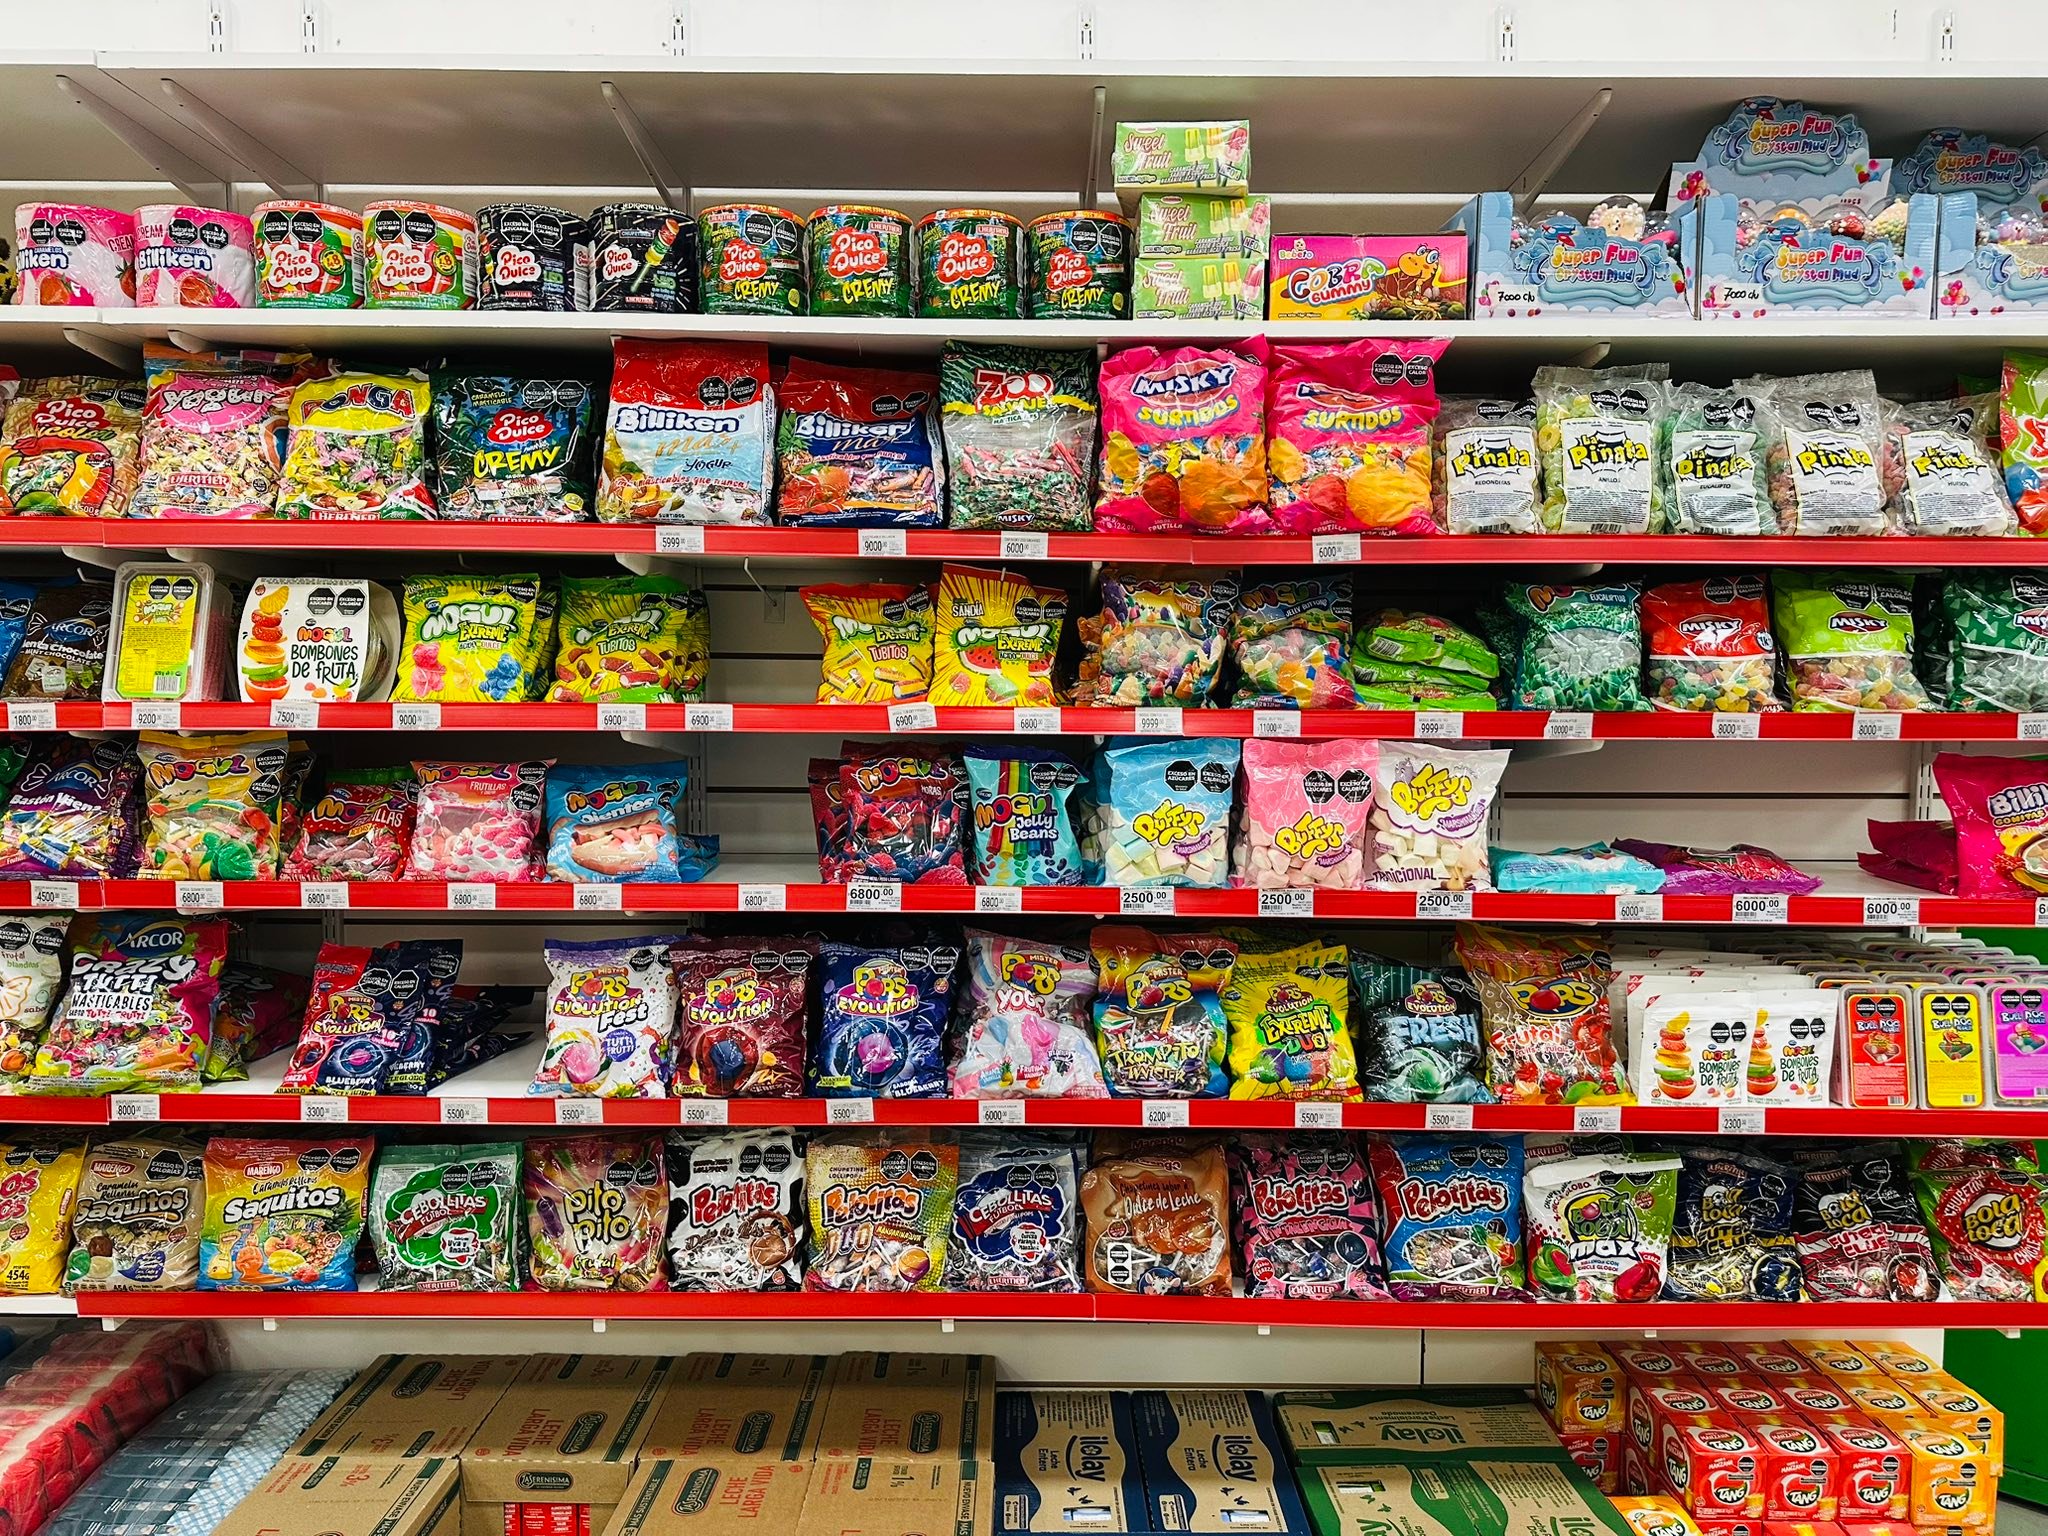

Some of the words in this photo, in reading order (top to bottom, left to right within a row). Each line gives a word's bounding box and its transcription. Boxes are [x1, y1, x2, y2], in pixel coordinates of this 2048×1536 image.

[1750, 120, 1798, 145] Super
[1803, 116, 1834, 134] Fun
[1123, 131, 1167, 154] Sweet
[1752, 141, 1800, 161] Crystal
[1803, 144, 1827, 159] Mud
[1937, 151, 1981, 172] Super
[1985, 148, 2018, 167] Fun
[1940, 170, 1983, 186] Crystal
[1985, 168, 2013, 183] Mud
[1150, 203, 1190, 222] Sweet
[137, 246, 212, 270] Billiken
[837, 236, 876, 257] Pico
[945, 237, 982, 260] Pico
[1551, 244, 1601, 267] Super
[1605, 244, 1639, 263] Fun
[1776, 244, 1827, 268] Super
[1830, 244, 1865, 263] Fun
[275, 253, 307, 271] Pico
[502, 254, 531, 268] Pico
[828, 253, 881, 275] Dulce
[940, 254, 988, 277] Dulce
[271, 268, 313, 286] Dulce
[1288, 259, 1387, 300] COBRA
[1556, 264, 1605, 282] Crystal
[1608, 266, 1635, 282] Mud
[1779, 264, 1830, 282] Crystal
[1832, 265, 1860, 281] Mud
[734, 278, 780, 301] CREMY
[842, 278, 894, 304] CREMY
[949, 280, 1001, 310] CREMY
[1060, 284, 1105, 309] CREMY
[974, 366, 1054, 404] ZOO
[1135, 365, 1236, 395] MISKY
[471, 392, 507, 402] CARAMELO
[498, 414, 540, 430] Pico
[615, 406, 739, 433] Billiken
[1303, 407, 1402, 432] SURTIDOS
[496, 424, 546, 441] Dulce
[473, 446, 561, 480] CREMY
[1567, 441, 1649, 472] Piñata
[1675, 460, 1752, 482] Piñata
[996, 513, 1034, 523] MISKY
[1241, 581, 1321, 611] MOGUL
[422, 602, 518, 641] MOGUL
[458, 621, 509, 643] EXTREME
[1682, 621, 1739, 636] MISKY
[1831, 616, 1887, 630] MISKY
[296, 626, 353, 642] MOGUL
[50, 643, 104, 661] Chocolate
[291, 645, 359, 663] BOMBONES
[597, 639, 636, 661] TUBITOS
[870, 648, 909, 666] TUBITOS
[150, 762, 249, 790] MOGUL
[421, 764, 509, 788] MOGUL
[470, 781, 506, 791] FRUTILLAS
[976, 795, 1056, 829] MOGUL
[1133, 801, 1204, 846] Buffys
[1010, 825, 1057, 842] Beans
[1016, 815, 1052, 833] Jelly
[7, 960, 40, 970] blanditos
[731, 970, 753, 981] MISTER
[1152, 966, 1183, 979] MISTER
[71, 993, 151, 1010] MASTICABLES
[840, 997, 917, 1015] EVOLUTION
[1407, 1001, 1456, 1013] EVOLUTION
[314, 1018, 384, 1034] EVOLUTION
[599, 1003, 648, 1031] Fest
[1259, 1006, 1331, 1043] EXTREME
[1394, 1013, 1475, 1046] FRESH
[606, 1036, 634, 1048] TUTTI
[606, 1046, 635, 1058] FRUTTI
[1283, 1032, 1327, 1056] DUO
[1107, 1041, 1199, 1068] TROMPITO
[325, 1075, 377, 1086] BLUEBERRY
[94, 1164, 132, 1179] MARENGO
[246, 1164, 283, 1177] MARENGO
[96, 1182, 139, 1196] Caramelos
[1252, 1181, 1347, 1219] Pelotitas
[1399, 1181, 1508, 1219] Pelotitas
[76, 1192, 186, 1220] Saquitos
[225, 1184, 342, 1222] Saquitos
[401, 1194, 488, 1226] CEBOLLITAS
[694, 1179, 780, 1228] Pelotitas
[825, 1183, 921, 1227] Pelotitas
[968, 1187, 1053, 1222] CEBOLLITAS
[1124, 1193, 1155, 1219] Dulce
[1156, 1193, 1171, 1210] de
[1173, 1189, 1203, 1212] Leche
[1965, 1194, 2021, 1231] BOLA
[1569, 1236, 1642, 1262] MAX
[1291, 1283, 1337, 1297] LHERITIER
[1576, 1362, 1606, 1374] TANG
[1709, 1362, 1743, 1375] TANG
[1832, 1359, 1862, 1372] TANG
[1897, 1360, 1928, 1373] TANG
[1869, 1397, 1905, 1411] TANG
[514, 1407, 551, 1434] LARGA
[532, 1418, 566, 1446] LECHE
[706, 1418, 734, 1446] LECHE
[502, 1431, 530, 1458] VIDA
[1078, 1435, 1112, 1483] ilolay
[1221, 1434, 1258, 1483] ilolay
[719, 1476, 750, 1506] LECHE
[737, 1485, 765, 1519] LARGA
[751, 1464, 776, 1490] VIDA
